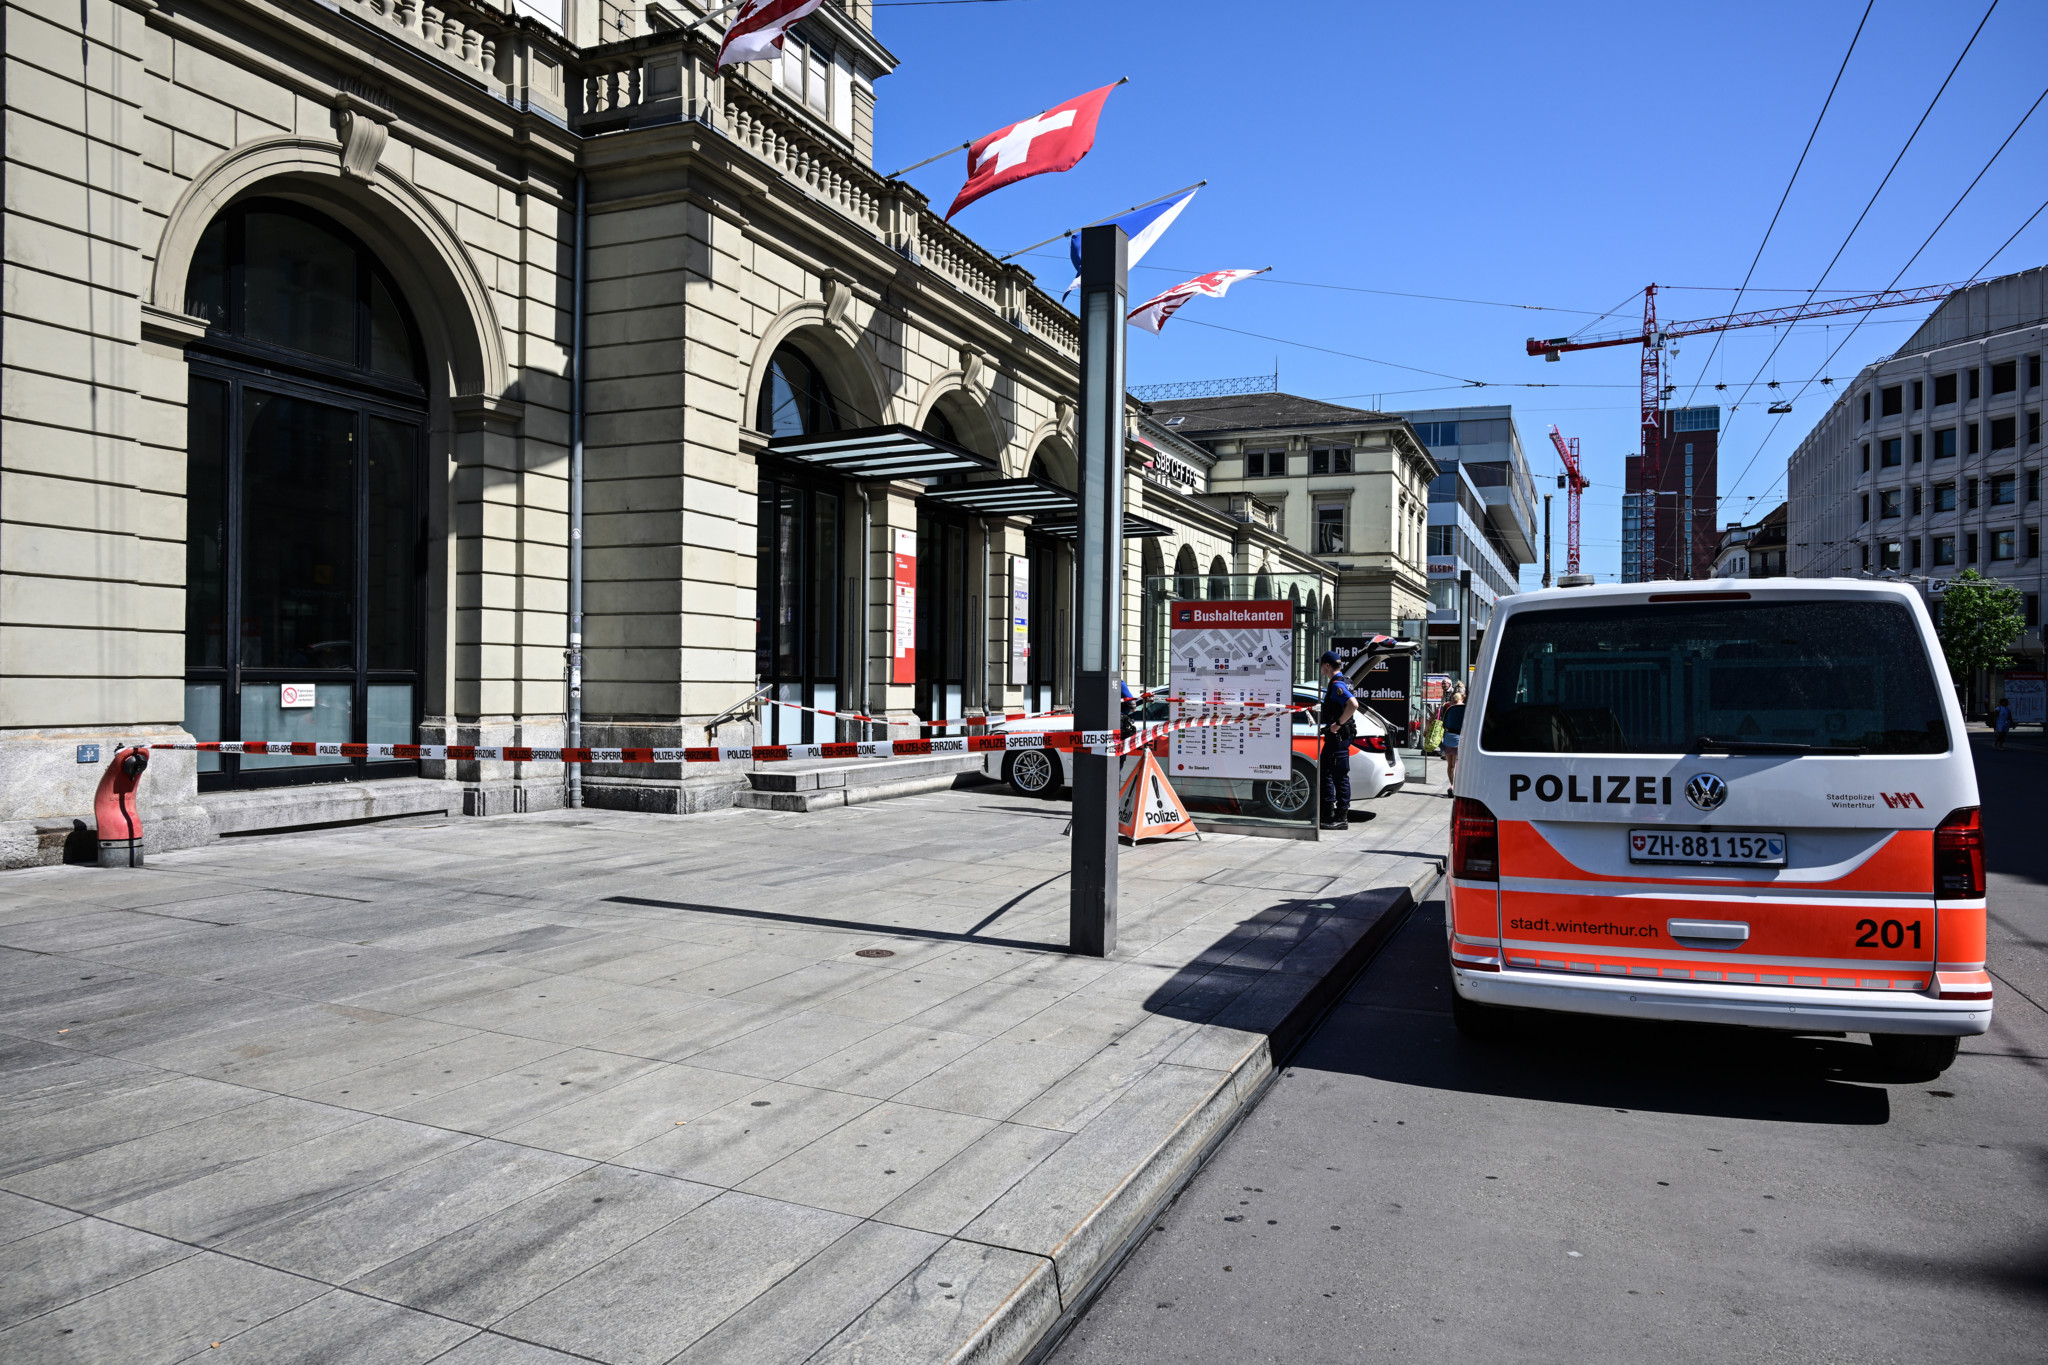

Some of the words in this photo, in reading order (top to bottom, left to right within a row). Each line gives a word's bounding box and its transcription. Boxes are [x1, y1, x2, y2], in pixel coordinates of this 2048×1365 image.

[1156, 452, 1170, 473] SBB
[1171, 458, 1184, 481] CFF
[1194, 609, 1284, 622] Bushaltekanten
[1335, 646, 1350, 657] Die
[1371, 687, 1405, 699] zahlen.
[319, 745, 369, 755] POLIZEI-SPERRZONE
[380, 746, 432, 757] POLIZEI-SPERRZONE
[443, 748, 497, 759] POLIZEI-SPERRZONE
[508, 750, 565, 760] POLIZEI-SPERRZONE
[577, 751, 637, 761] POLIZEI-SPERRZONE
[651, 750, 713, 760] POLIZEI-SPERRZONE
[727, 748, 793, 759] POLIZEI-SPERRZONE
[807, 744, 877, 757] POLIZEI-SPERRZONE
[892, 739, 963, 753] POLIZEI-SPERRZONE
[979, 735, 1053, 749] POLIZEI-SPERRZONE
[1509, 774, 1672, 805] POLIZEI
[1826, 793, 1875, 802] Stadtpolizei
[1119, 807, 1133, 824] nfall
[1145, 808, 1180, 825] Polizei
[1509, 917, 1659, 938] stadt.winterthur.ch
[1854, 918, 1922, 950] 201
